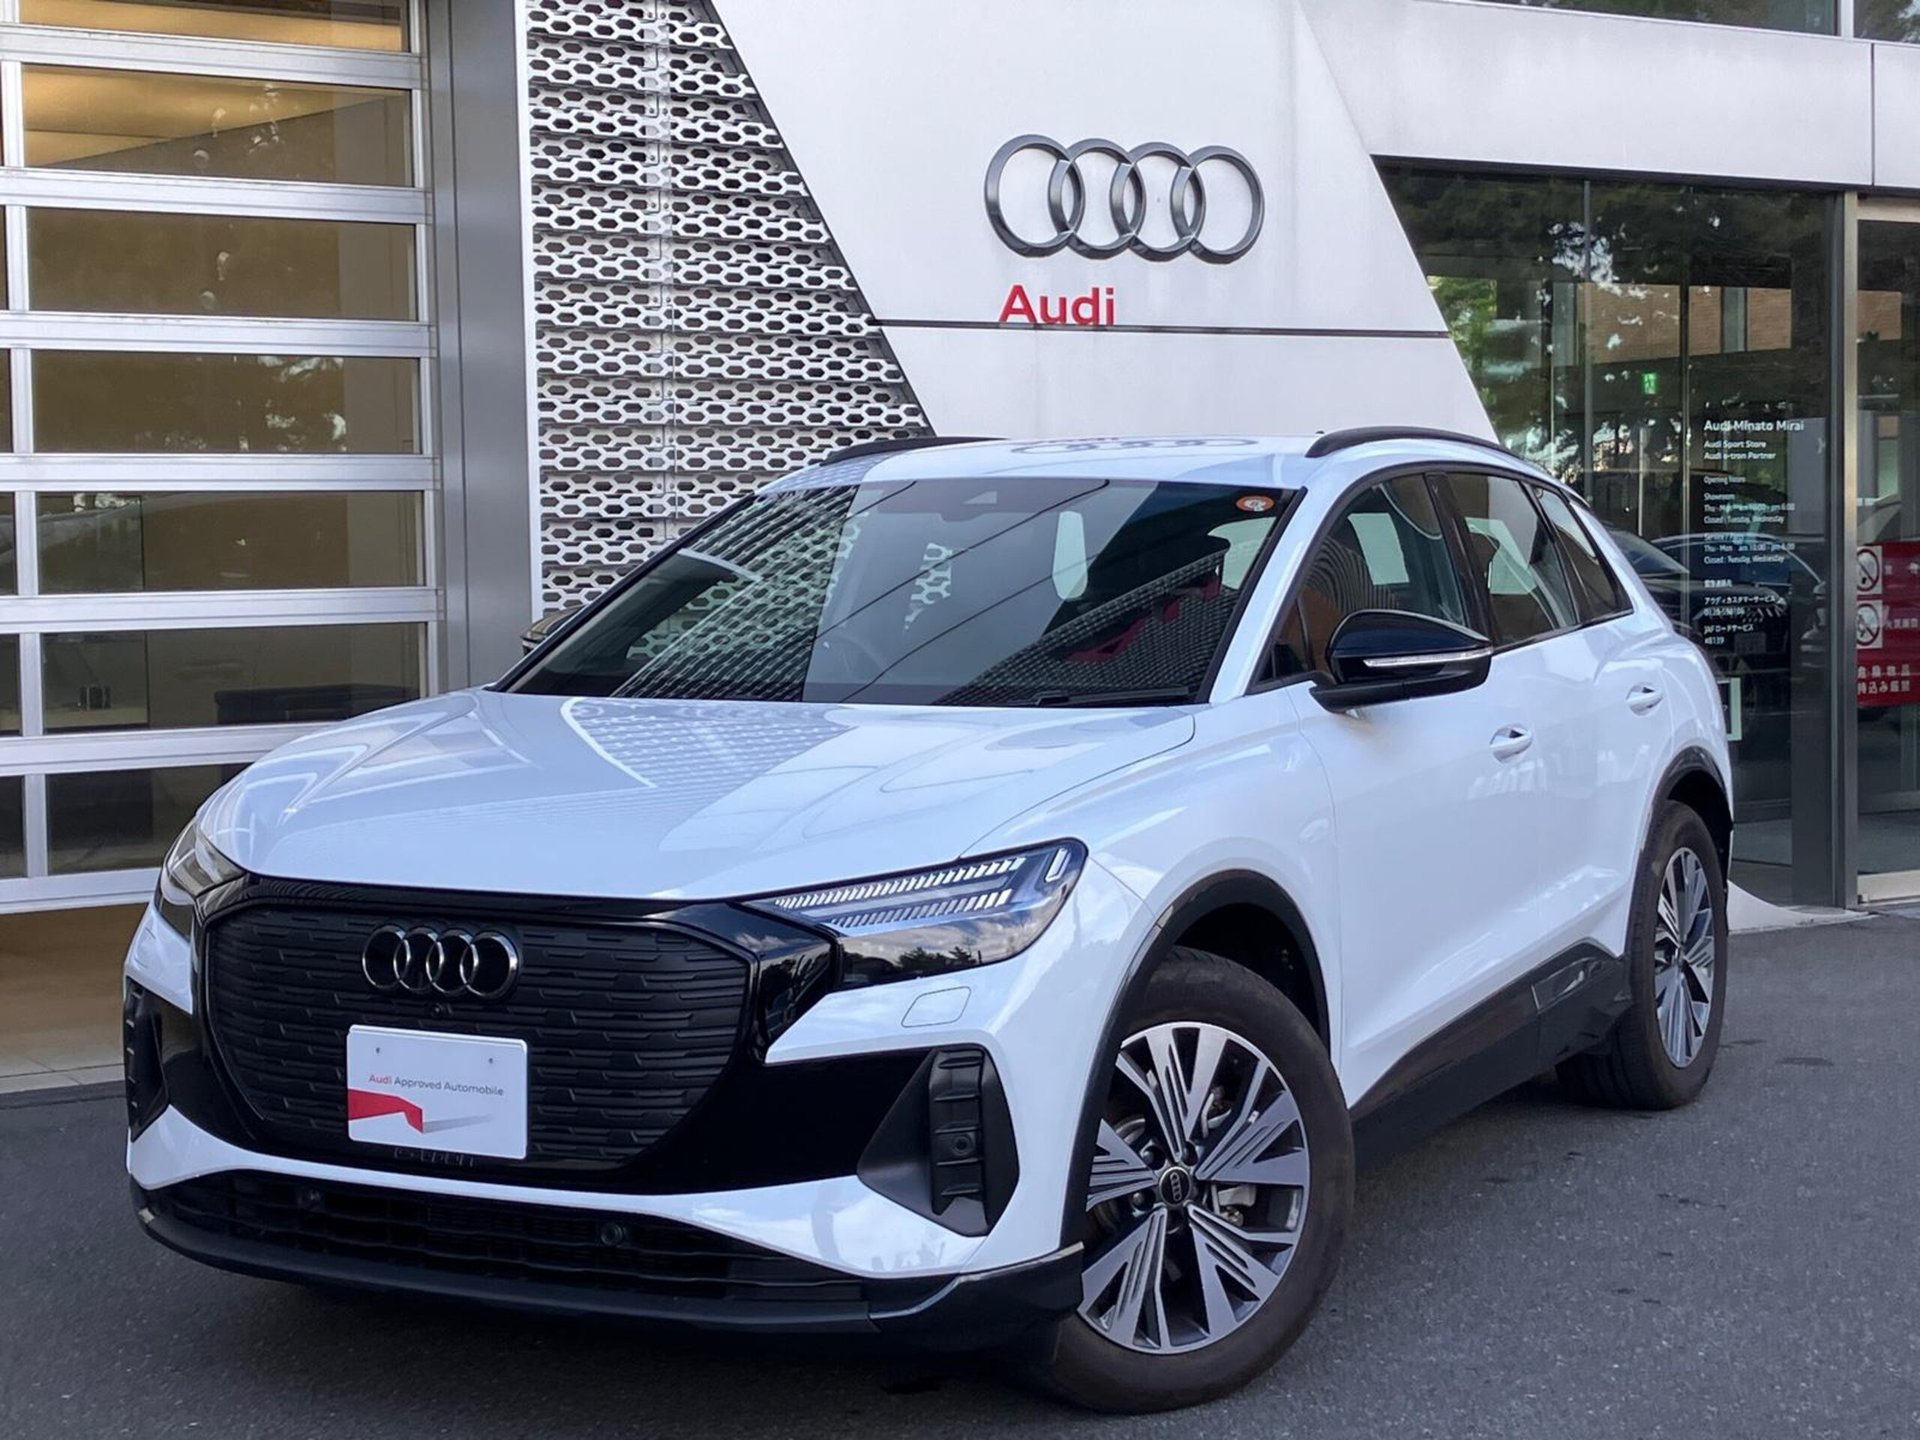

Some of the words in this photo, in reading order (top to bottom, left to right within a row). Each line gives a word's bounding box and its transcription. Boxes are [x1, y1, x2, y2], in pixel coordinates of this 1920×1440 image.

[998, 284, 1115, 327] Audi
[1703, 420, 1731, 431] Audi
[1733, 420, 1774, 431] Minato
[1776, 420, 1804, 431] Mirai
[1723, 440, 1744, 449] Sport
[1745, 440, 1767, 448] Store
[1747, 451, 1776, 460] Partner
[368, 1073, 392, 1085] Audi
[394, 1076, 442, 1090] Approved
[443, 1081, 504, 1097] Automobile
